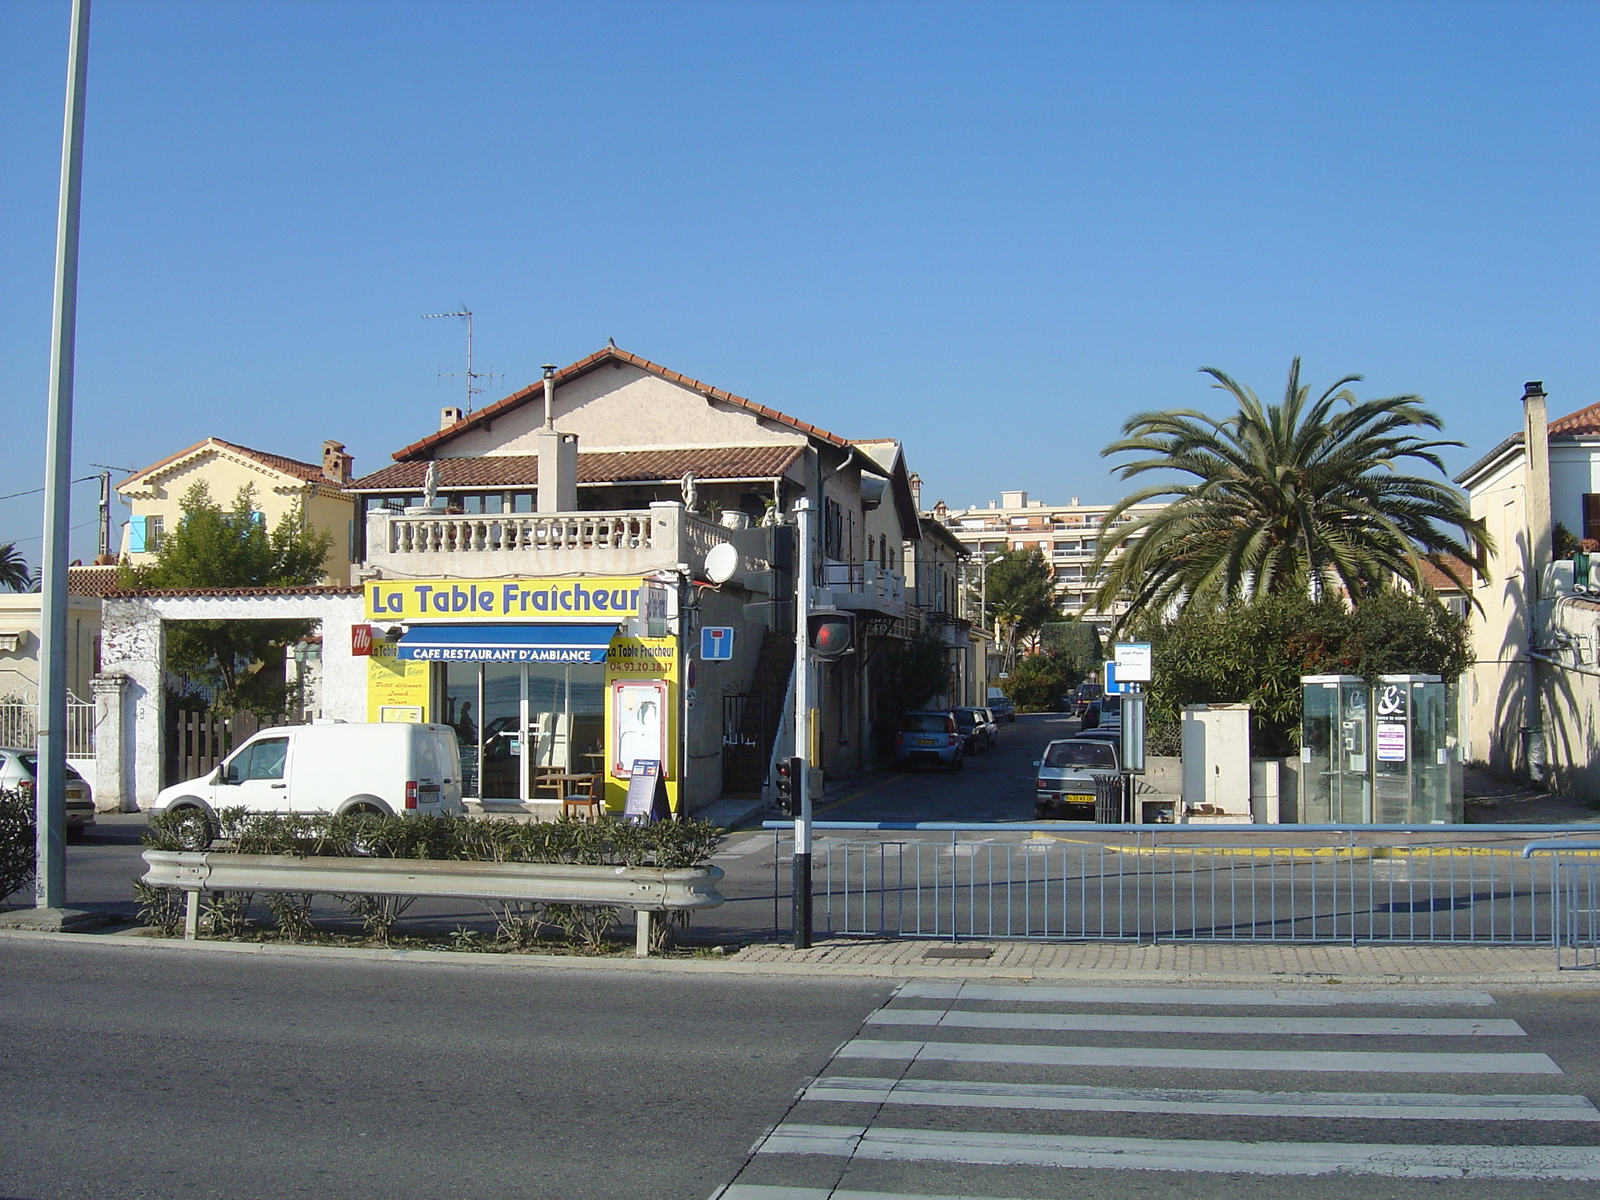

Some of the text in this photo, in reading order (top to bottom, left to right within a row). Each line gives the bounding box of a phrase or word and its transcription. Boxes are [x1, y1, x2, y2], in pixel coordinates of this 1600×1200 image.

[373, 587, 403, 612] La
[414, 585, 495, 612] Table
[503, 583, 639, 615] Fraîcheur
[353, 629, 371, 653] illy
[413, 649, 591, 661] CAFE RESTAURANT D'AMBIANCE
[618, 645, 638, 657] Table
[610, 662, 673, 672] 04.93.20.38.17
